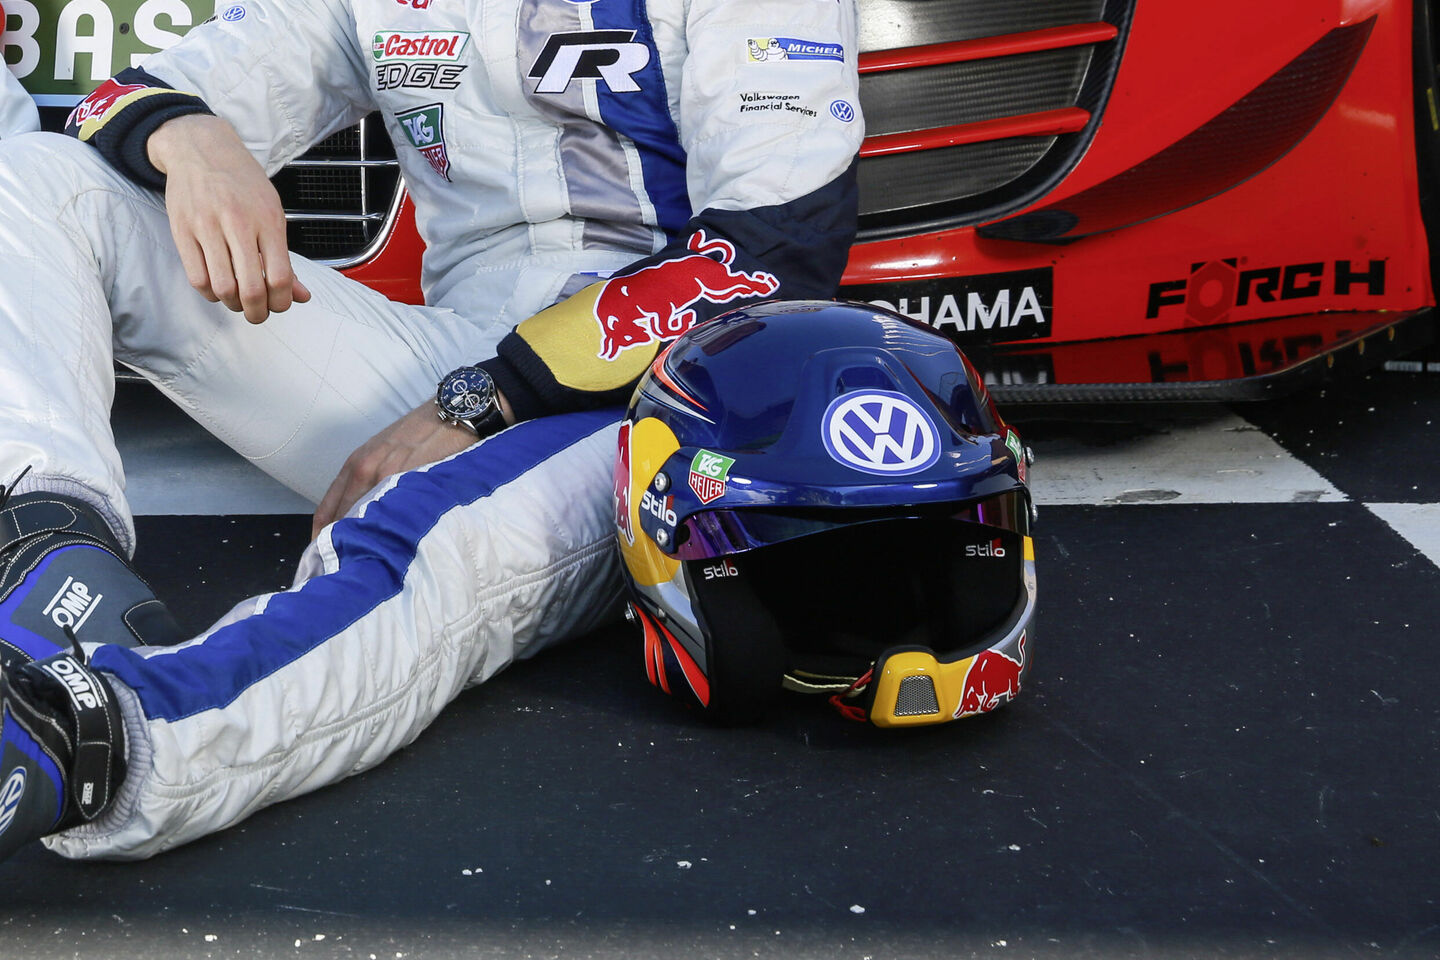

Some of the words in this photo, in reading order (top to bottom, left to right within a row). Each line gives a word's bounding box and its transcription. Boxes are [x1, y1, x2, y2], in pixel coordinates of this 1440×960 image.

[384, 33, 460, 57] Castrol
[375, 63, 468, 91] EDGE
[739, 92, 800, 102] Volkswagen
[739, 101, 783, 114] Financial
[784, 102, 818, 118] Services
[697, 452, 723, 475] TAG
[690, 474, 725, 502] HEUER
[641, 488, 678, 527] stilo
[965, 540, 1006, 558] stilo
[703, 561, 739, 581] stilo
[51, 580, 93, 630] OMP
[51, 658, 97, 709] OMP
